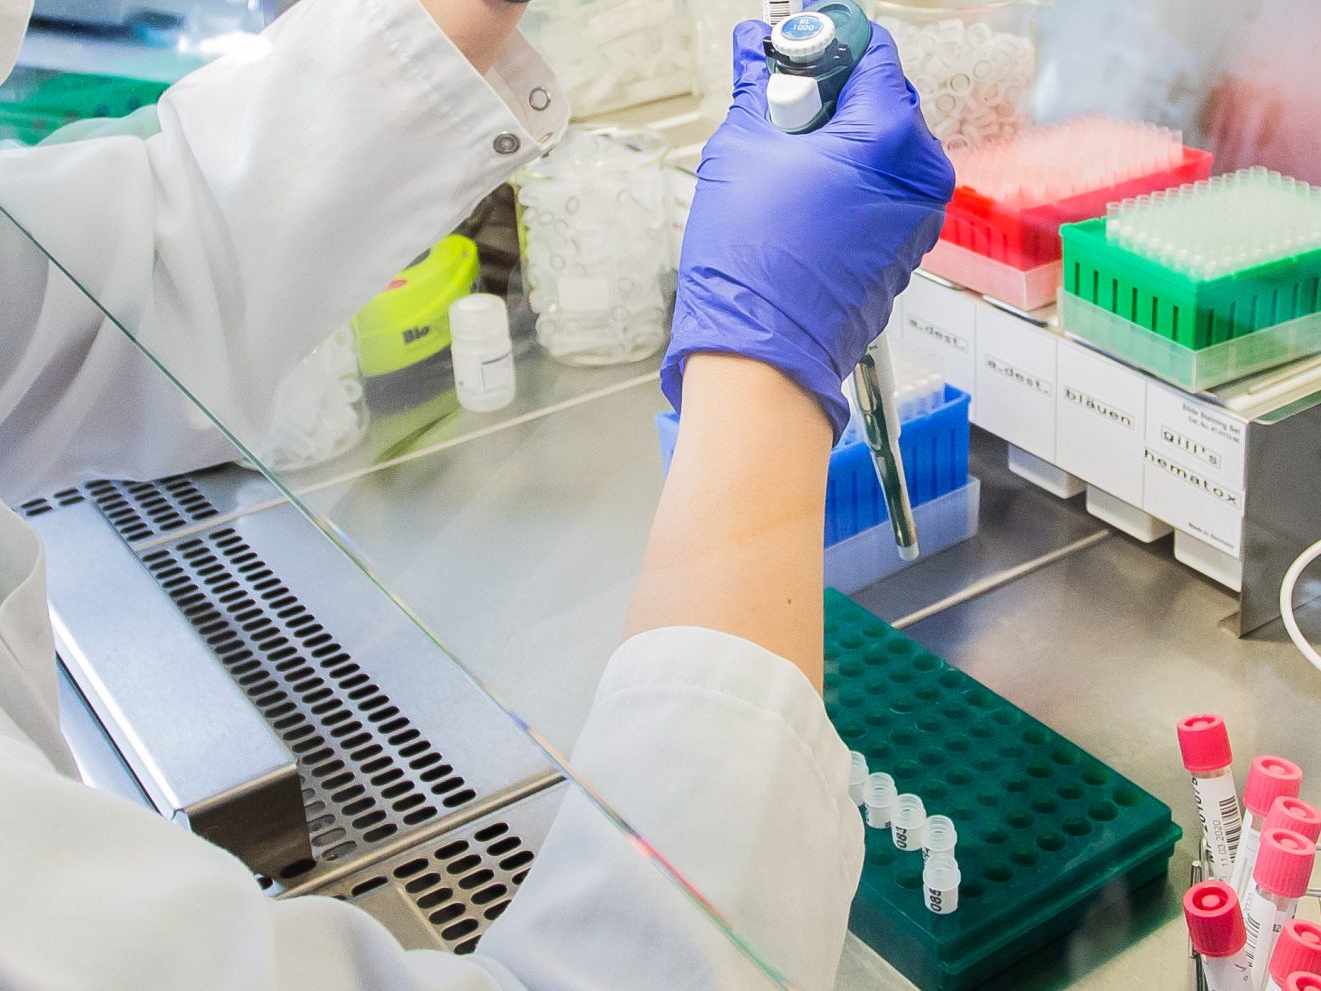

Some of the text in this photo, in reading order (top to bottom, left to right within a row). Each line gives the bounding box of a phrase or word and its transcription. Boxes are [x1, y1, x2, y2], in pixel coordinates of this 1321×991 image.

[1066, 389, 1131, 425] bläuen
[1163, 431, 1217, 465] gill's
[1144, 449, 1237, 505] hematox
